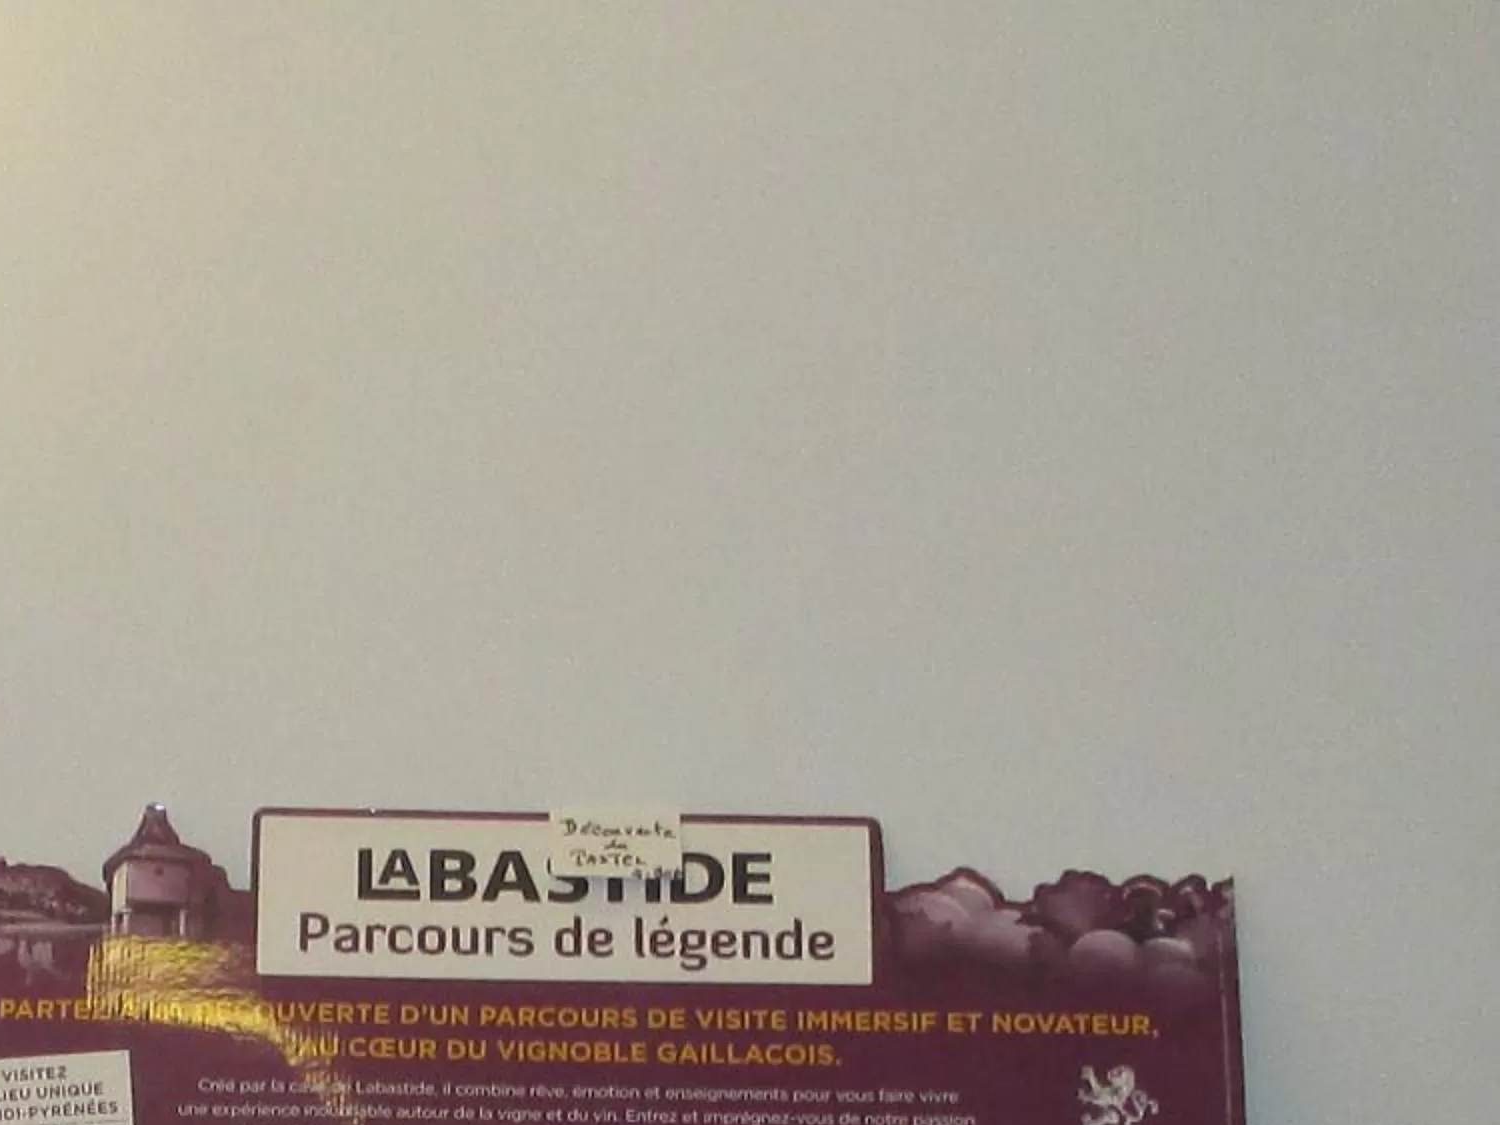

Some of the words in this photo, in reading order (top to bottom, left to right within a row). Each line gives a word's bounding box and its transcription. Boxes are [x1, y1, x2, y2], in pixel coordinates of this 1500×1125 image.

[298, 912, 535, 957] Parcours
[554, 915, 615, 958] de
[633, 915, 836, 972] légende
[401, 1004, 470, 1027] D'UN
[479, 1005, 638, 1029] PARCOURS
[648, 1008, 687, 1030] DE
[695, 1008, 788, 1031] VISITE
[798, 1010, 937, 1033] IMMERSIF
[947, 1012, 984, 1034] ET
[991, 1011, 1160, 1038] NOVATEUR,
[439, 1039, 488, 1062] DU
[497, 1039, 647, 1065] VIGNOBLE
[657, 1041, 843, 1068] GAILLACOIS.
[0, 1065, 68, 1083] VISITEZ
[35, 1081, 105, 1099] UNIQUE
[240, 1080, 266, 1097] par
[270, 1078, 285, 1094] la
[454, 1083, 526, 1098] combine
[572, 1083, 640, 1100] émotion
[643, 1086, 661, 1100] et
[664, 1087, 788, 1103] enseignements
[792, 1089, 831, 1104] pour
[835, 1090, 876, 1103] vous
[878, 1087, 915, 1103] faire
[919, 1088, 959, 1104] vivre
[177, 1104, 208, 1117] une
[211, 1102, 300, 1120] expérience
[396, 1106, 449, 1120] autour
[453, 1105, 475, 1120] de
[479, 1106, 493, 1120] la
[497, 1107, 542, 1123] vigne
[546, 1108, 563, 1121] et
[567, 1107, 588, 1122] du
[625, 1108, 677, 1124] Entrez
[681, 1110, 698, 1124] et
